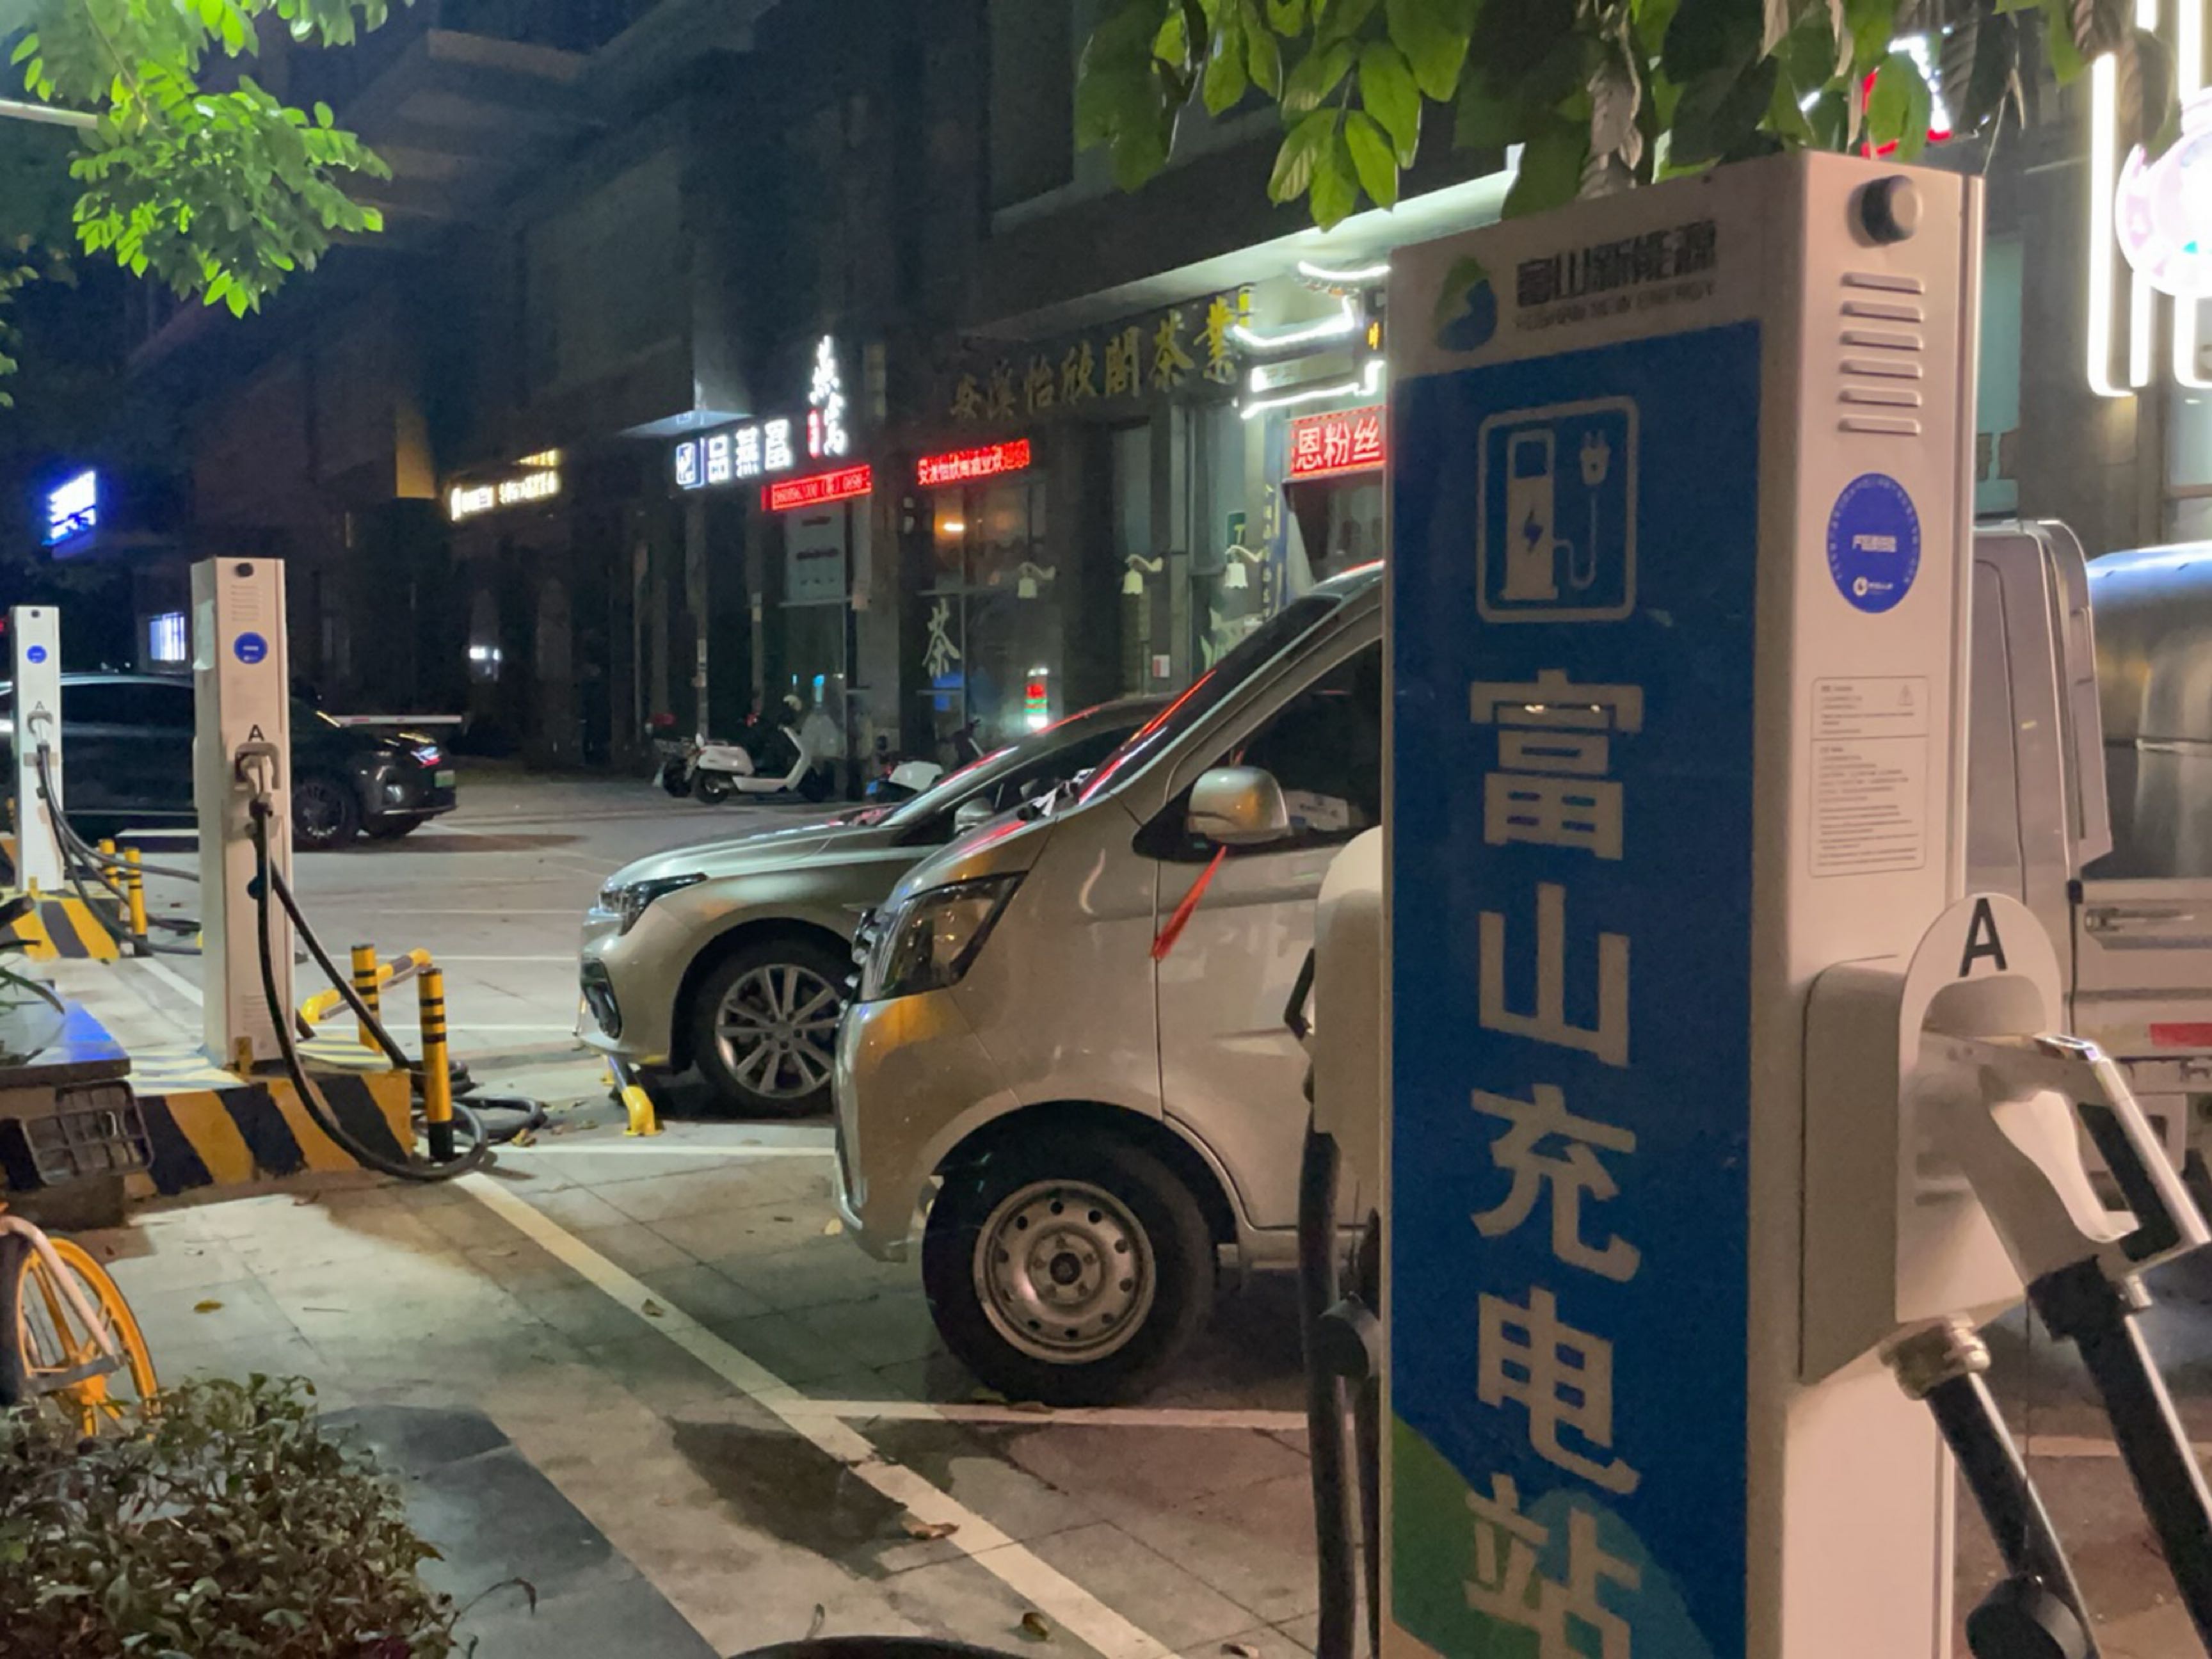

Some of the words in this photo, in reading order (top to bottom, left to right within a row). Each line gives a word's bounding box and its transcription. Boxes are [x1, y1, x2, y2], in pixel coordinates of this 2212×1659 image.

[1295, 415, 1380, 471] 恩粉丝
[248, 724, 264, 742] A
[1959, 897, 2008, 978] A
[1464, 668, 1644, 1659] 富山充电站
